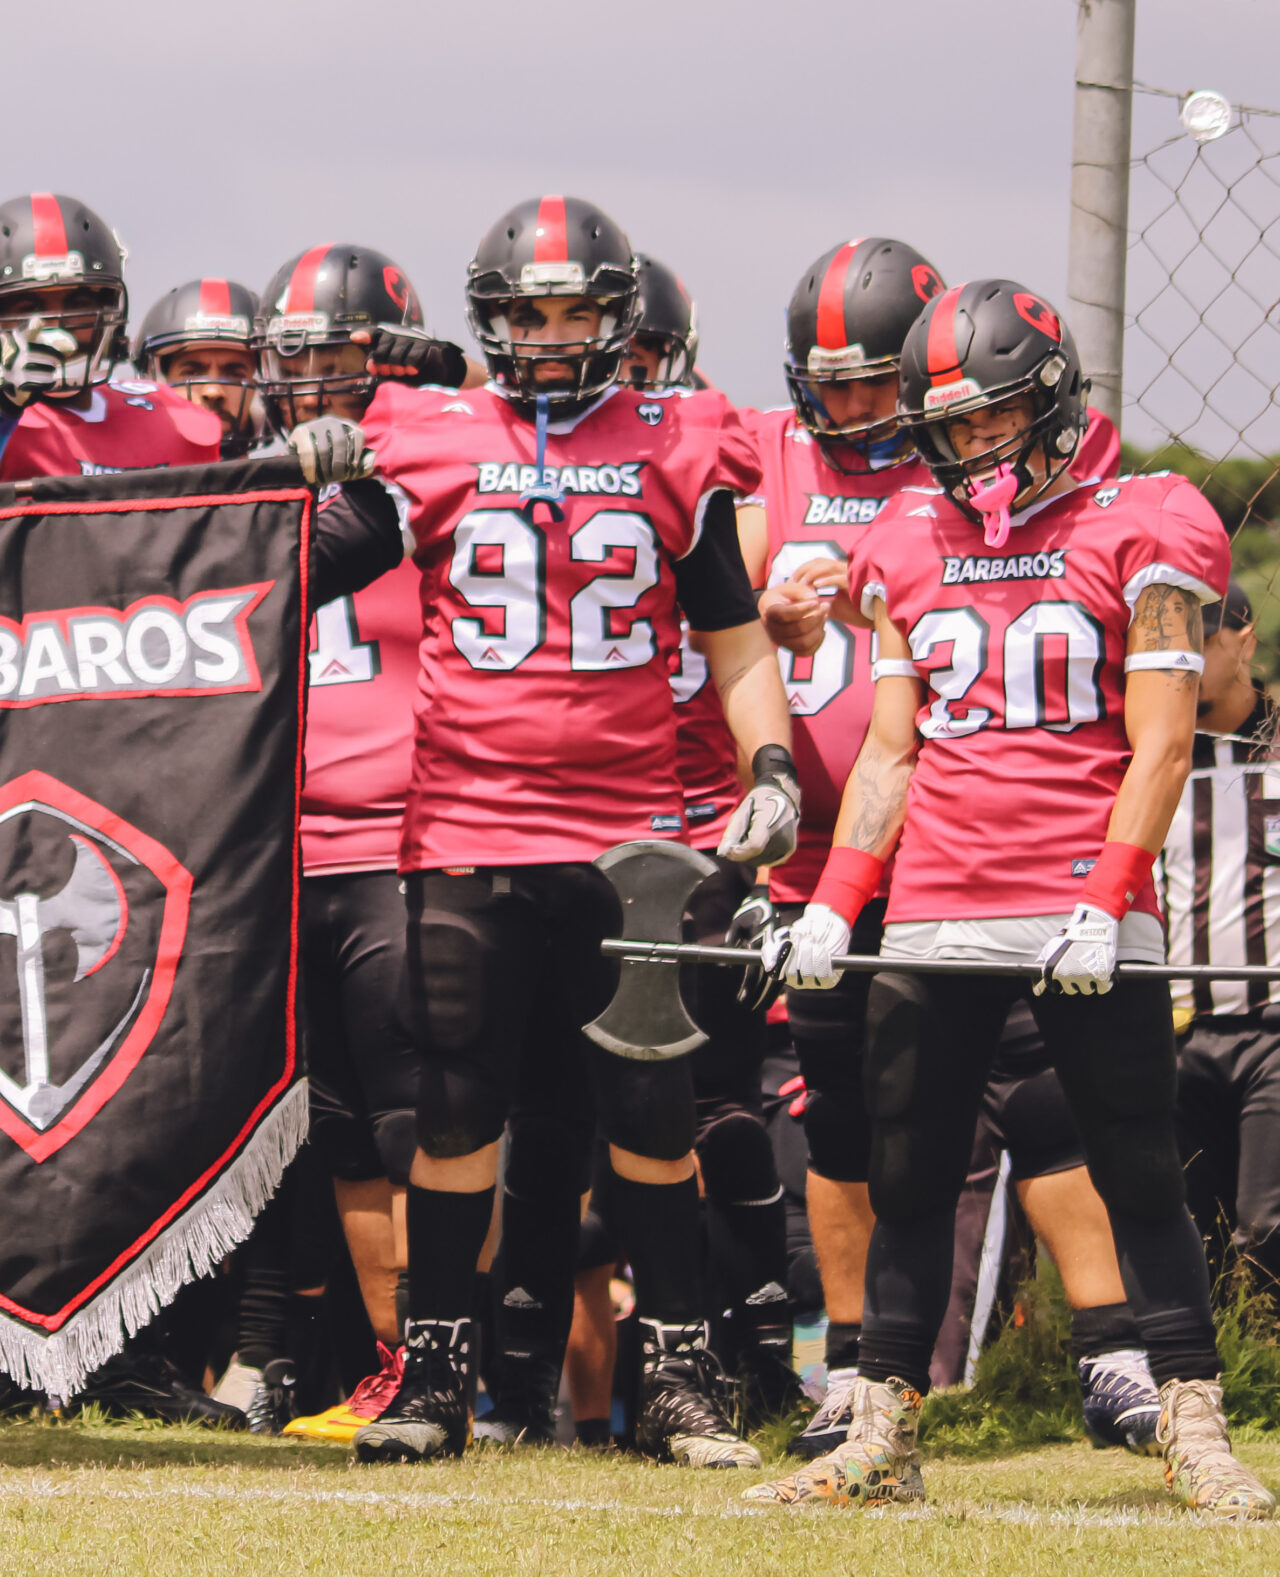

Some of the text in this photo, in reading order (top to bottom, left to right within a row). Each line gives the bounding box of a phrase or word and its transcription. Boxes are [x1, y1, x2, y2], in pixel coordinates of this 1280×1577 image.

[927, 385, 971, 405] Riddell
[804, 496, 888, 524] BARB
[943, 550, 1066, 584] BARBAROS
[448, 507, 661, 671] 92
[908, 601, 1107, 739] 20
